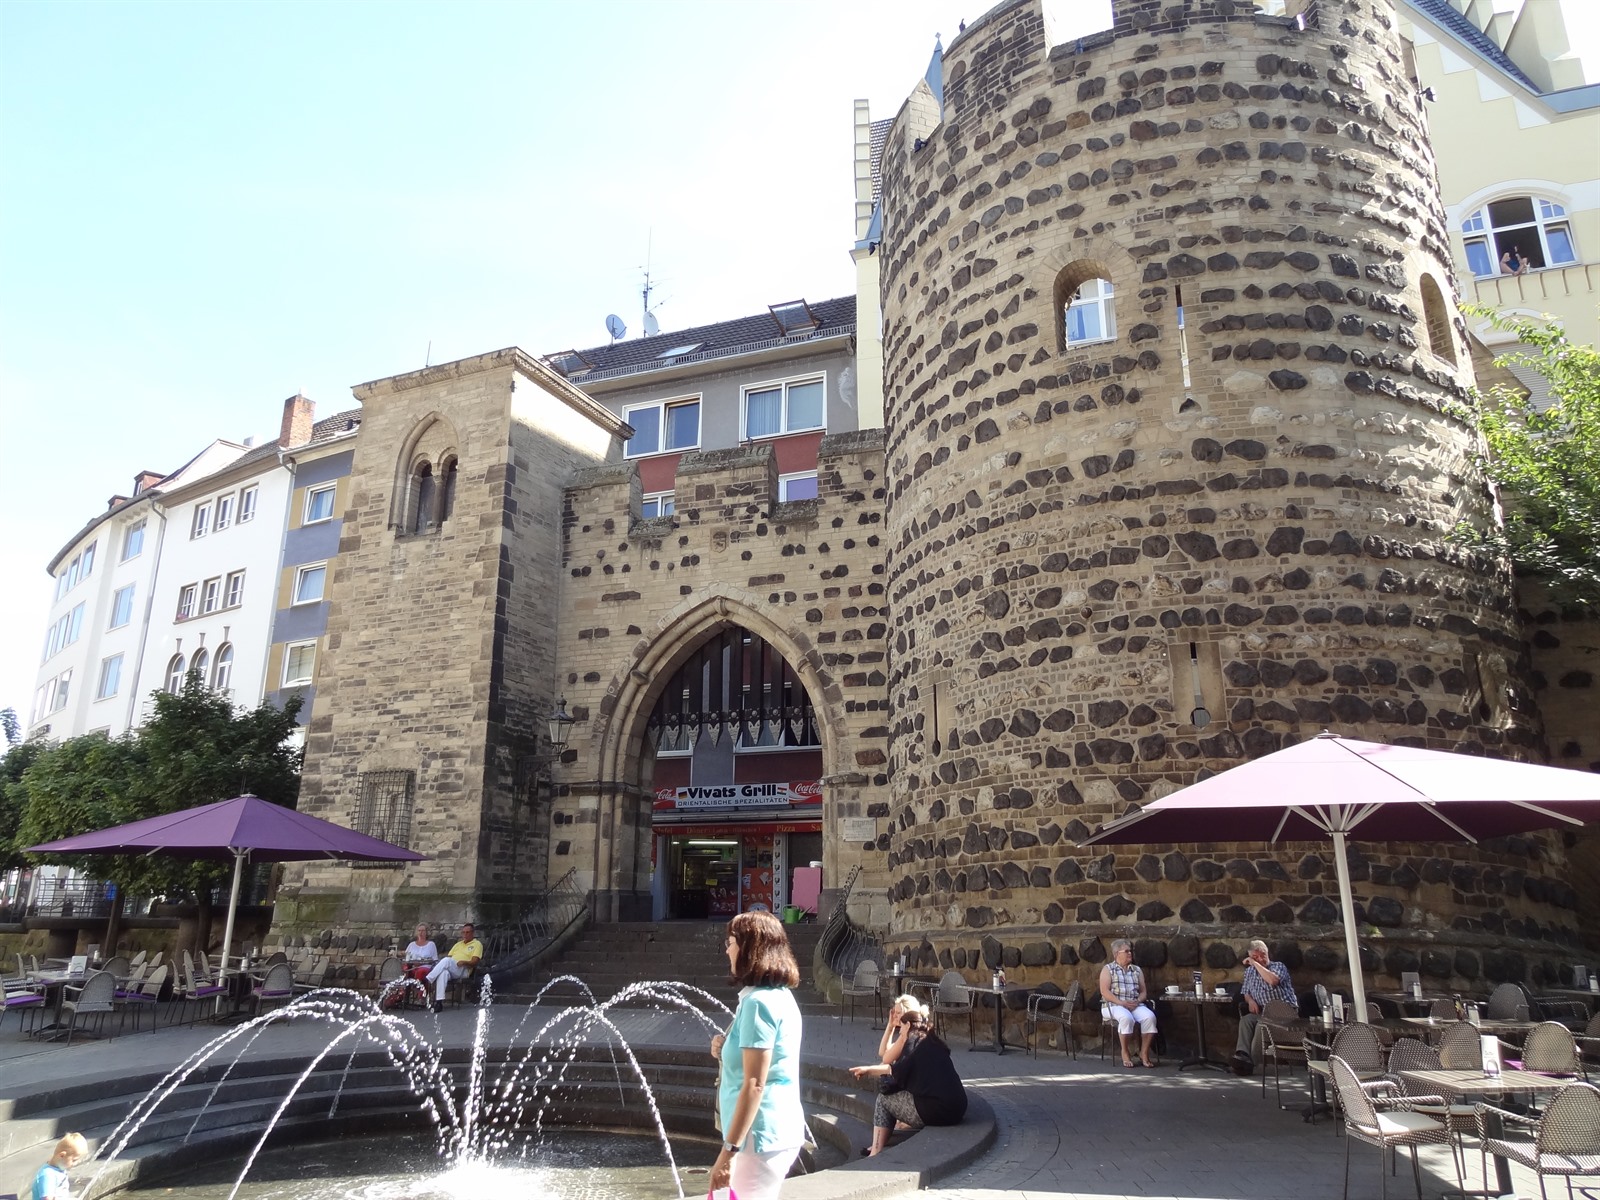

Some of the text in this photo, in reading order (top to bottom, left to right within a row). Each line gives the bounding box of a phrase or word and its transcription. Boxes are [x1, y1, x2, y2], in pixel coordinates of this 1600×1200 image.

[687, 784, 777, 799] Vivats Grill
[678, 797, 788, 807] ORIENTALISCHE SPEZIALITÄTEN
[776, 824, 796, 832] Pizza
